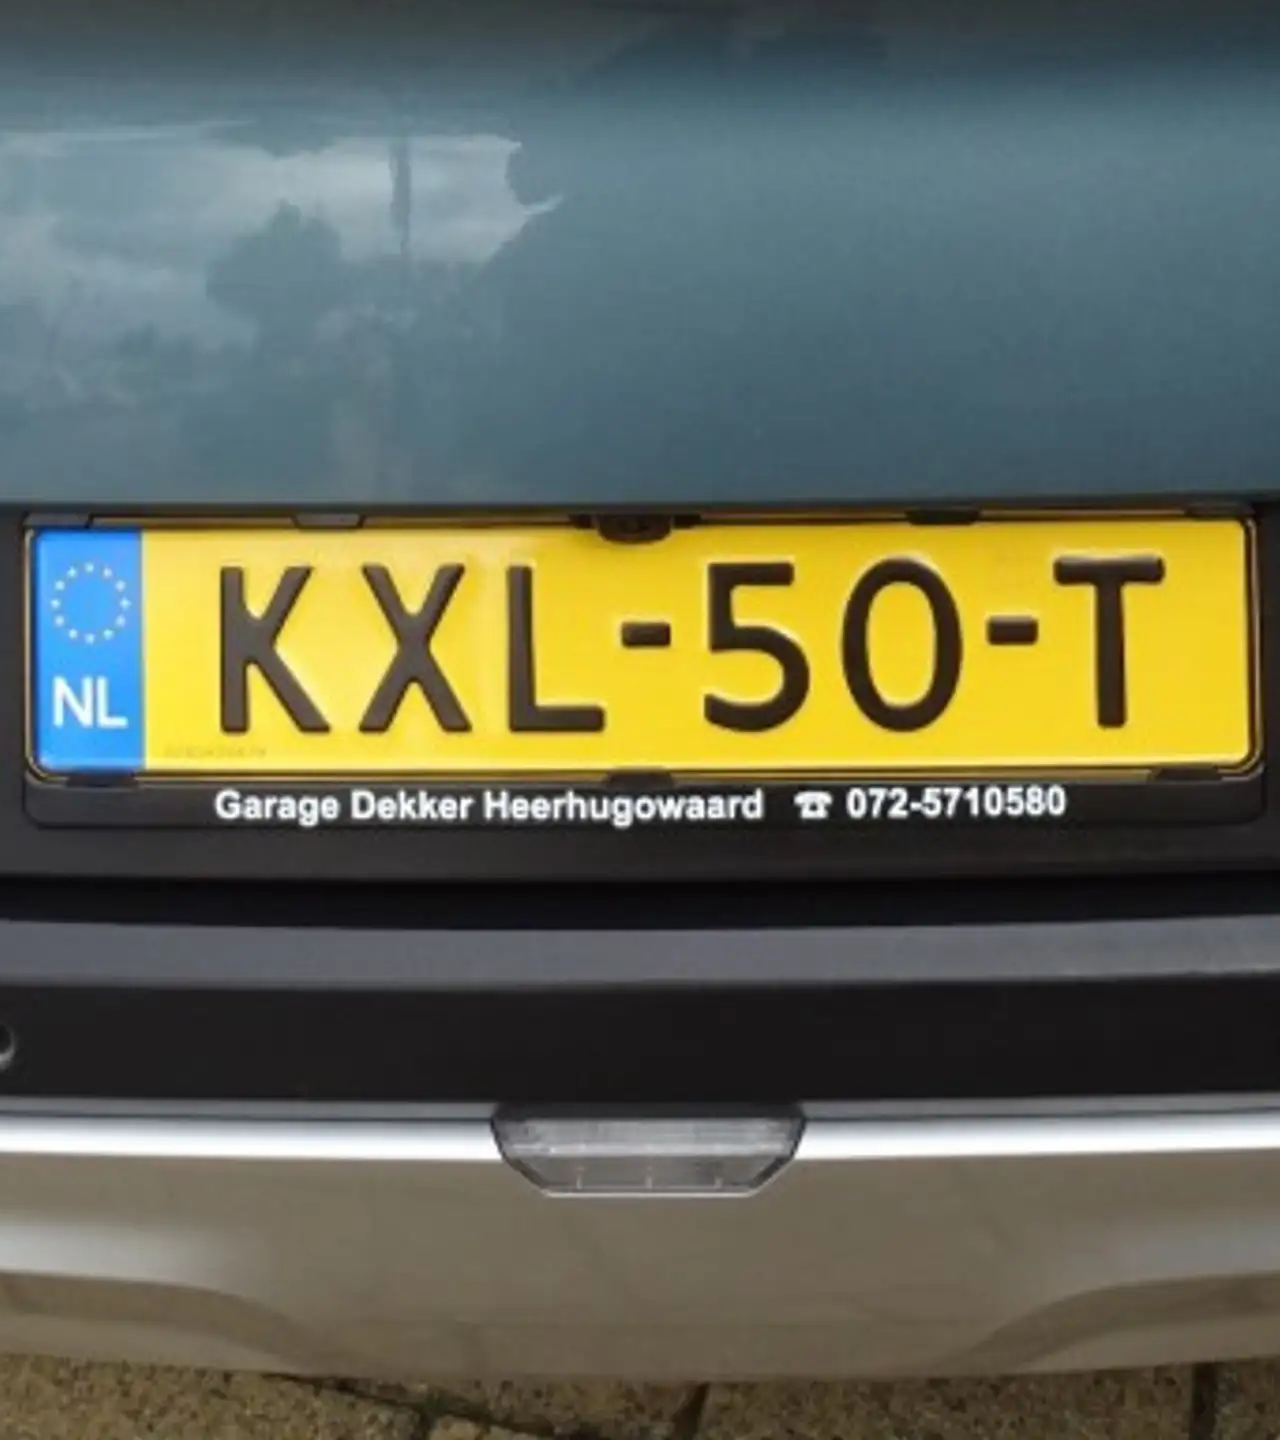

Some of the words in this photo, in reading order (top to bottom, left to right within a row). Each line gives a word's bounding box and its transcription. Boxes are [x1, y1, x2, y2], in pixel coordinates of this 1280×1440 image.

[52, 675, 127, 728] NL
[218, 557, 1166, 735] KXL-50-T
[214, 788, 341, 828] Garage
[350, 788, 475, 821] Dekker
[483, 788, 764, 829] Heerhugowaard
[846, 786, 1067, 819] 072-5710580
